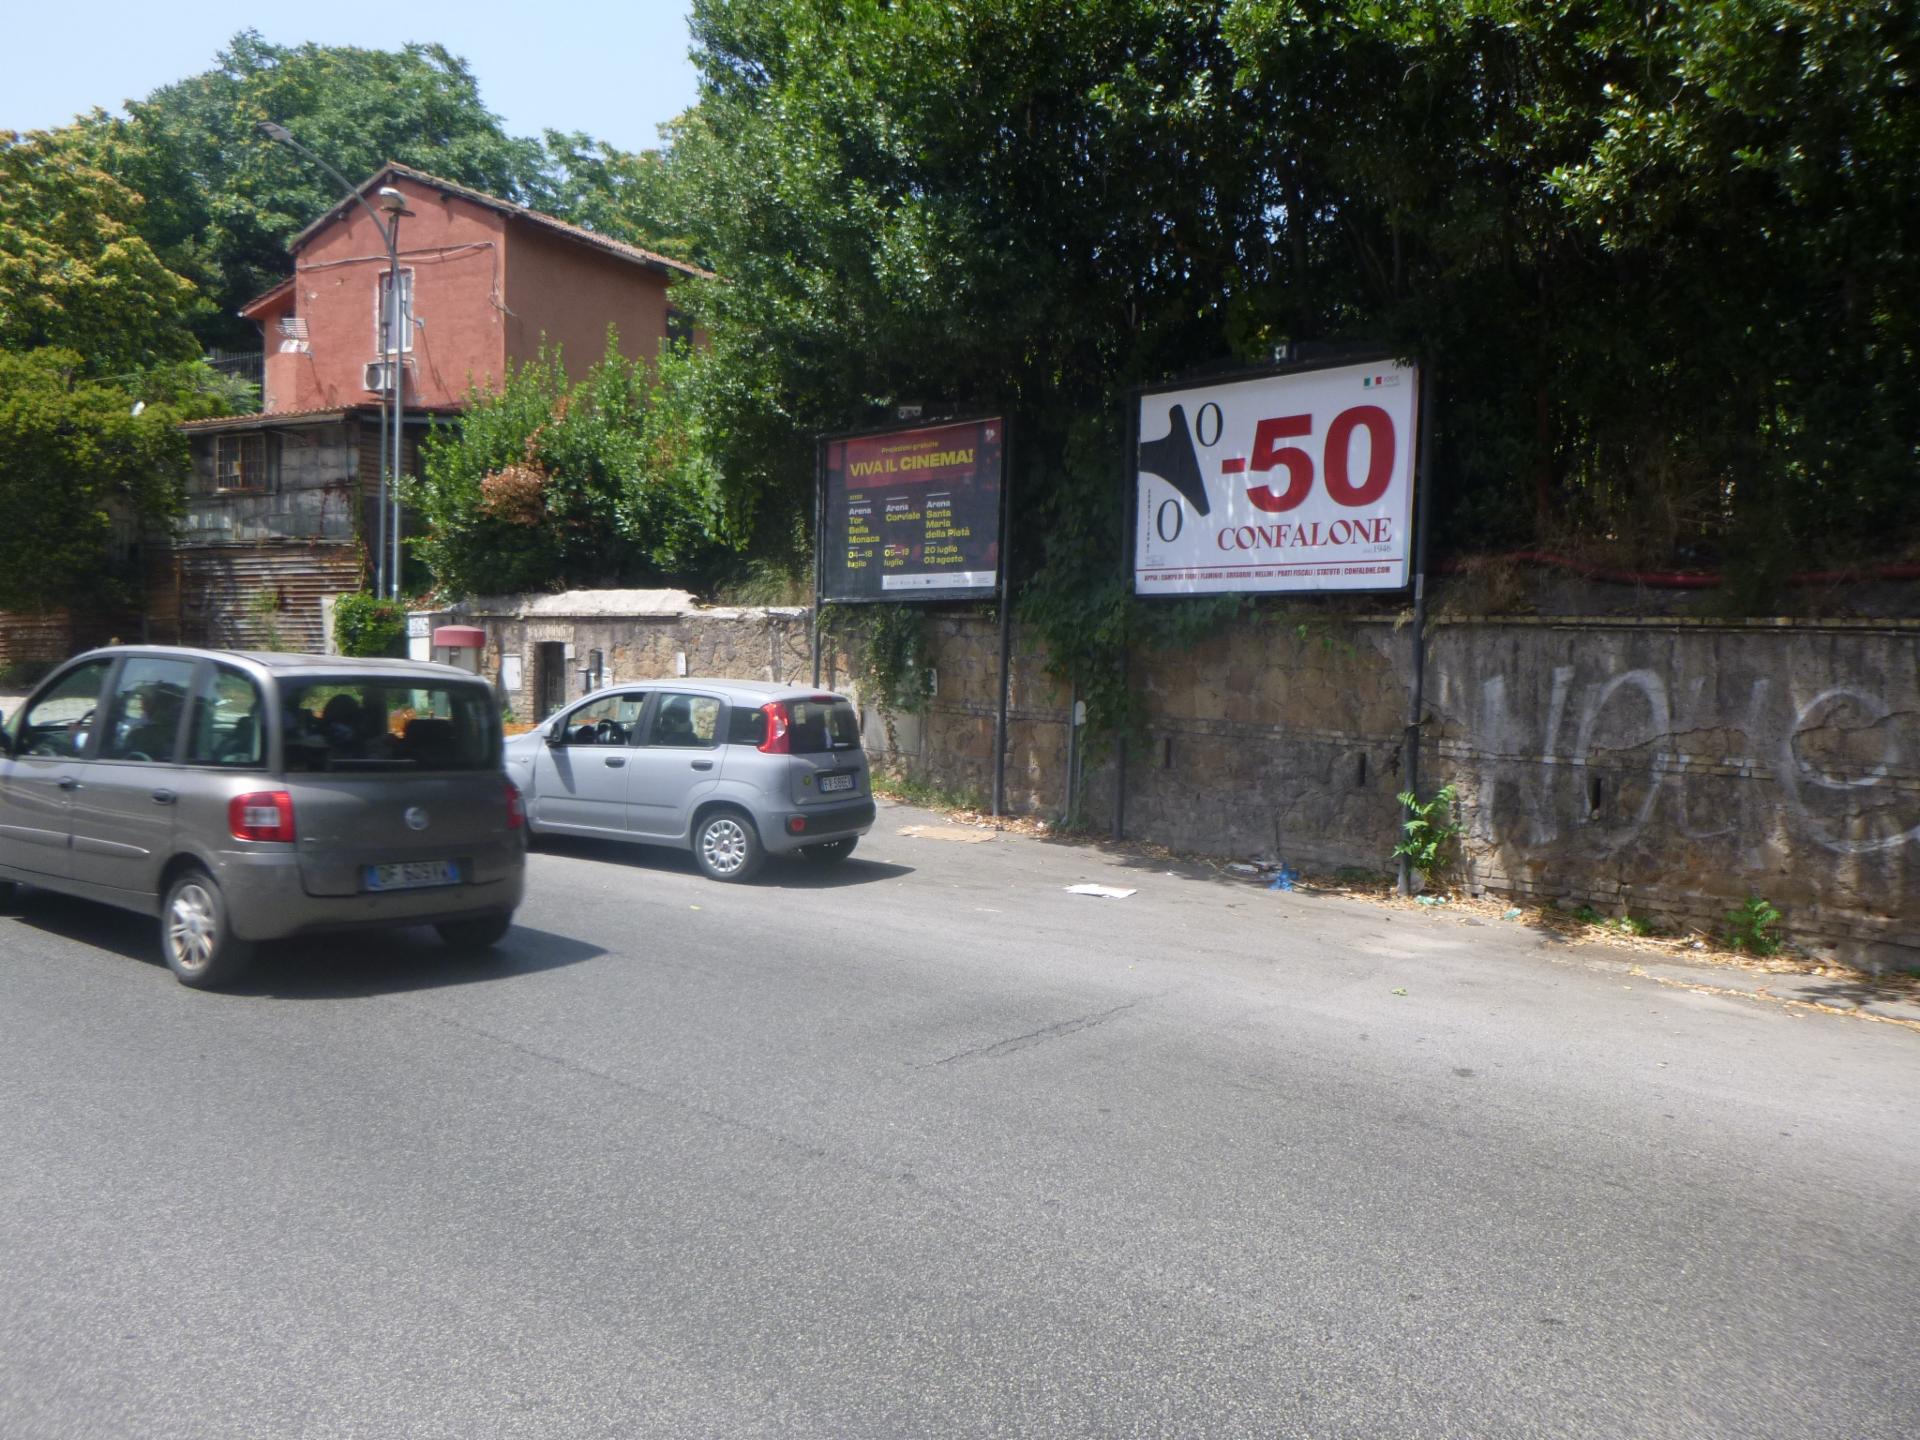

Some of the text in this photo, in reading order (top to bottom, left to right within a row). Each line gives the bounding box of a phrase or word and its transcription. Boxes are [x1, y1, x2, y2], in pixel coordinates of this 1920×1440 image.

[850, 449, 974, 477] VIVA IL CINEMA!
[886, 504, 909, 512] Arena
[926, 500, 952, 508] Arena
[849, 507, 872, 515] Arena
[926, 510, 952, 518] Santa
[886, 511, 921, 521] Corviale
[849, 517, 863, 525] Tor
[926, 520, 951, 528] Maria
[925, 530, 946, 539] della
[1217, 517, 1393, 551] CONFALONE
[849, 535, 880, 544] Monaca
[937, 545, 958, 555] luglio
[884, 559, 904, 568] luglio
[936, 555, 964, 565] agosto
[1344, 566, 1391, 575] CONFALONE.COM
